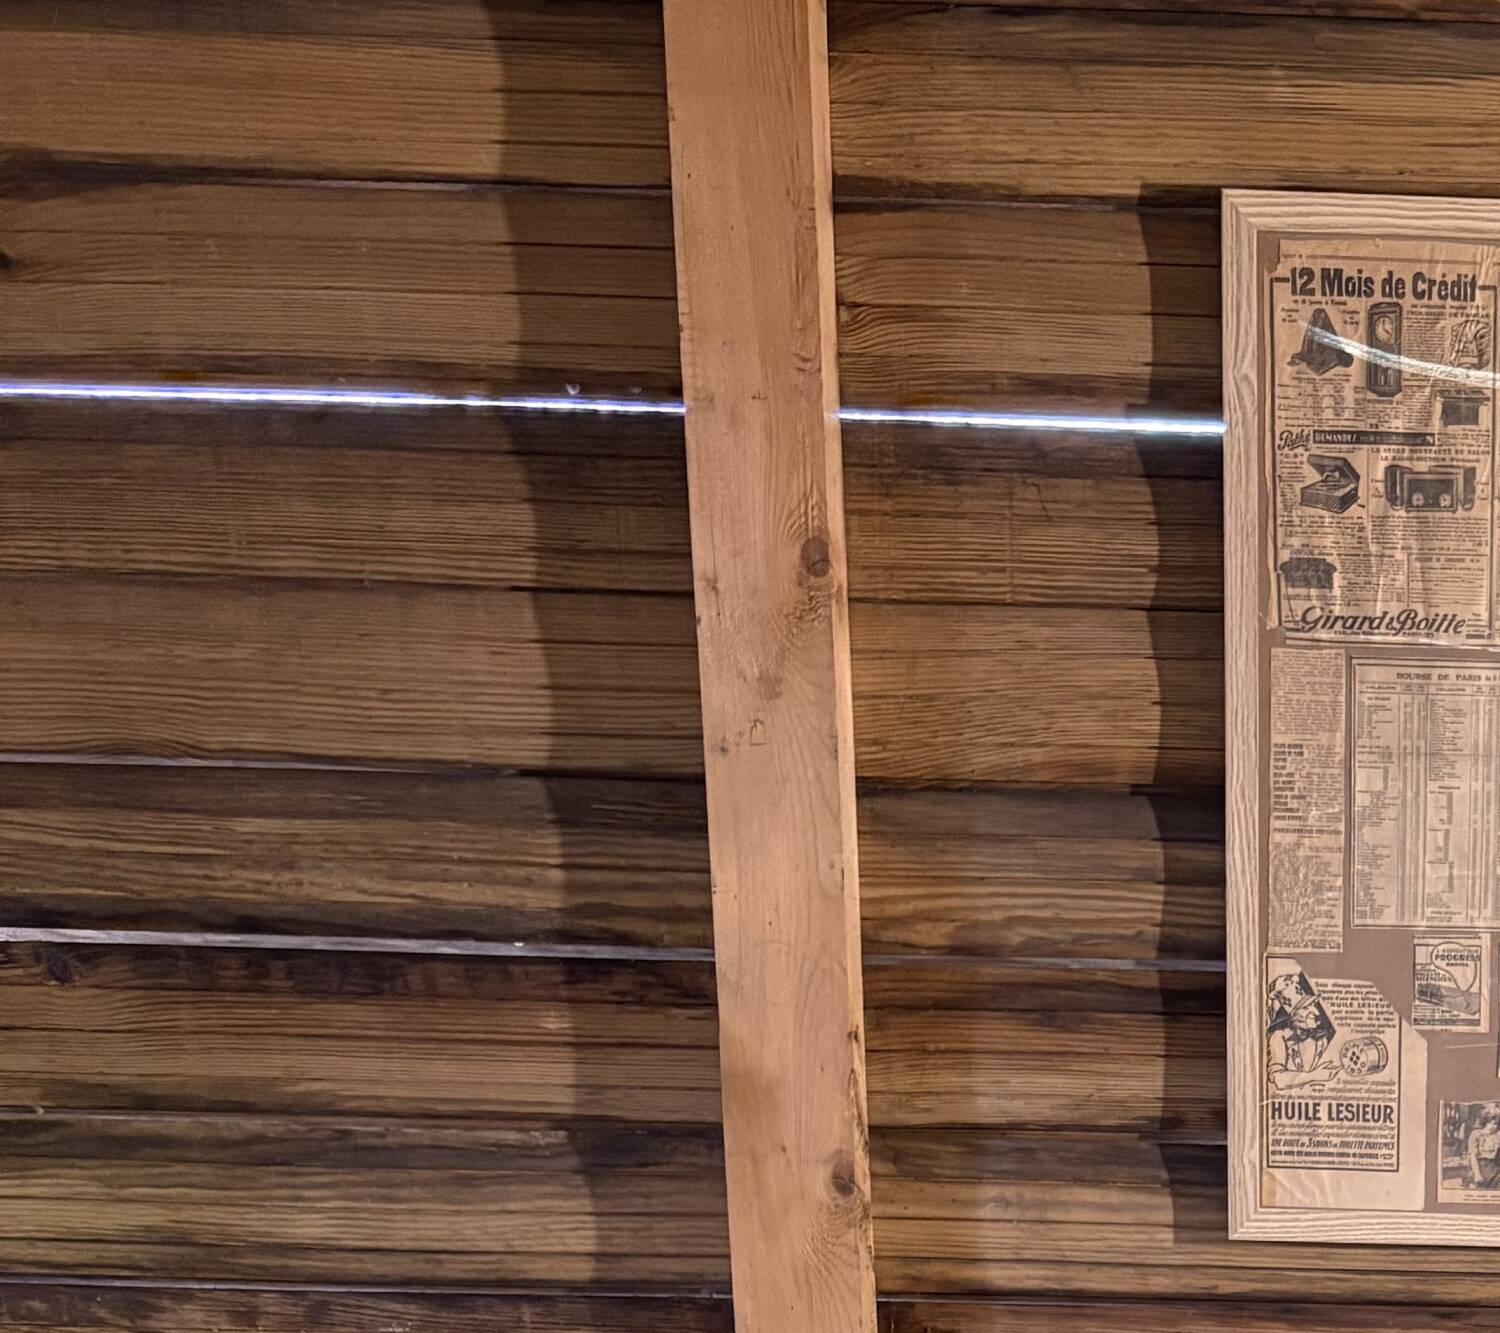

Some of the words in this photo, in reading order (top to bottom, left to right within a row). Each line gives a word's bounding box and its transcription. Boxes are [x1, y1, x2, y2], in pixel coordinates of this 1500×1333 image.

[1290, 267, 1316, 297] 12
[1321, 268, 1375, 298] Mois
[1381, 271, 1406, 300] de
[1412, 271, 1477, 302] Crédit
[1301, 605, 1386, 634] Girard
[1396, 672, 1432, 680] BOURSE
[1438, 673, 1449, 681] DE
[1456, 674, 1482, 682] PARIS
[1271, 1101, 1321, 1121] HUILE
[1327, 1102, 1395, 1124] LESIEUR
